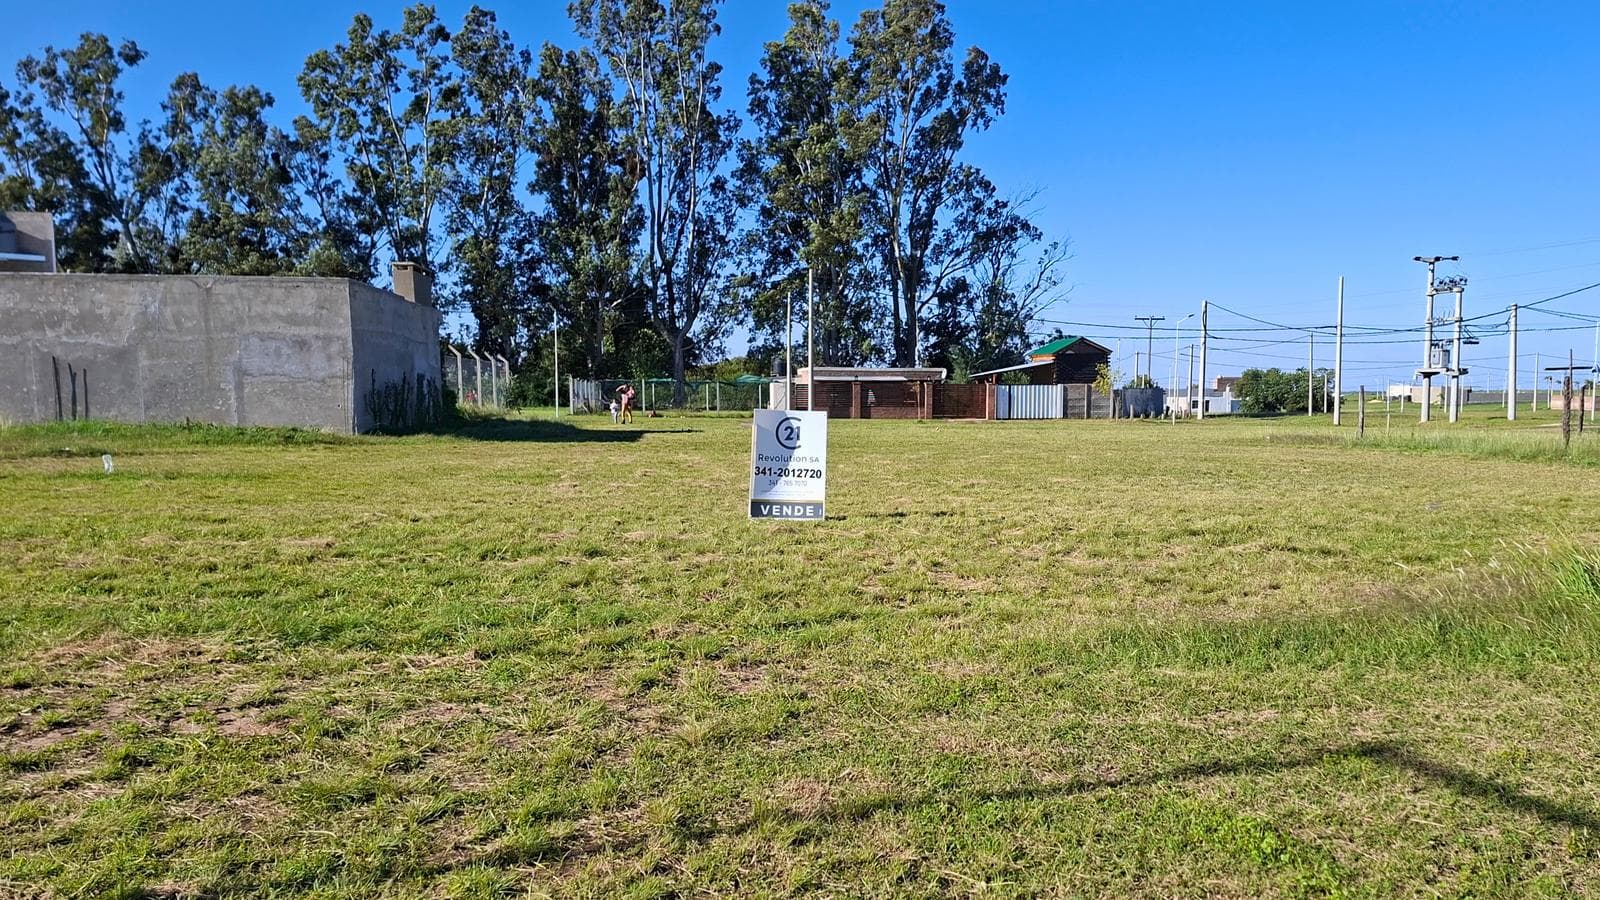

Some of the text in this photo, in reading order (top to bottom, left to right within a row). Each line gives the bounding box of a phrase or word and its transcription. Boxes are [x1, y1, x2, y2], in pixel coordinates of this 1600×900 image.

[758, 453, 808, 463] Revolution
[754, 466, 822, 479] 341-2012720
[760, 504, 814, 516] VENDE
